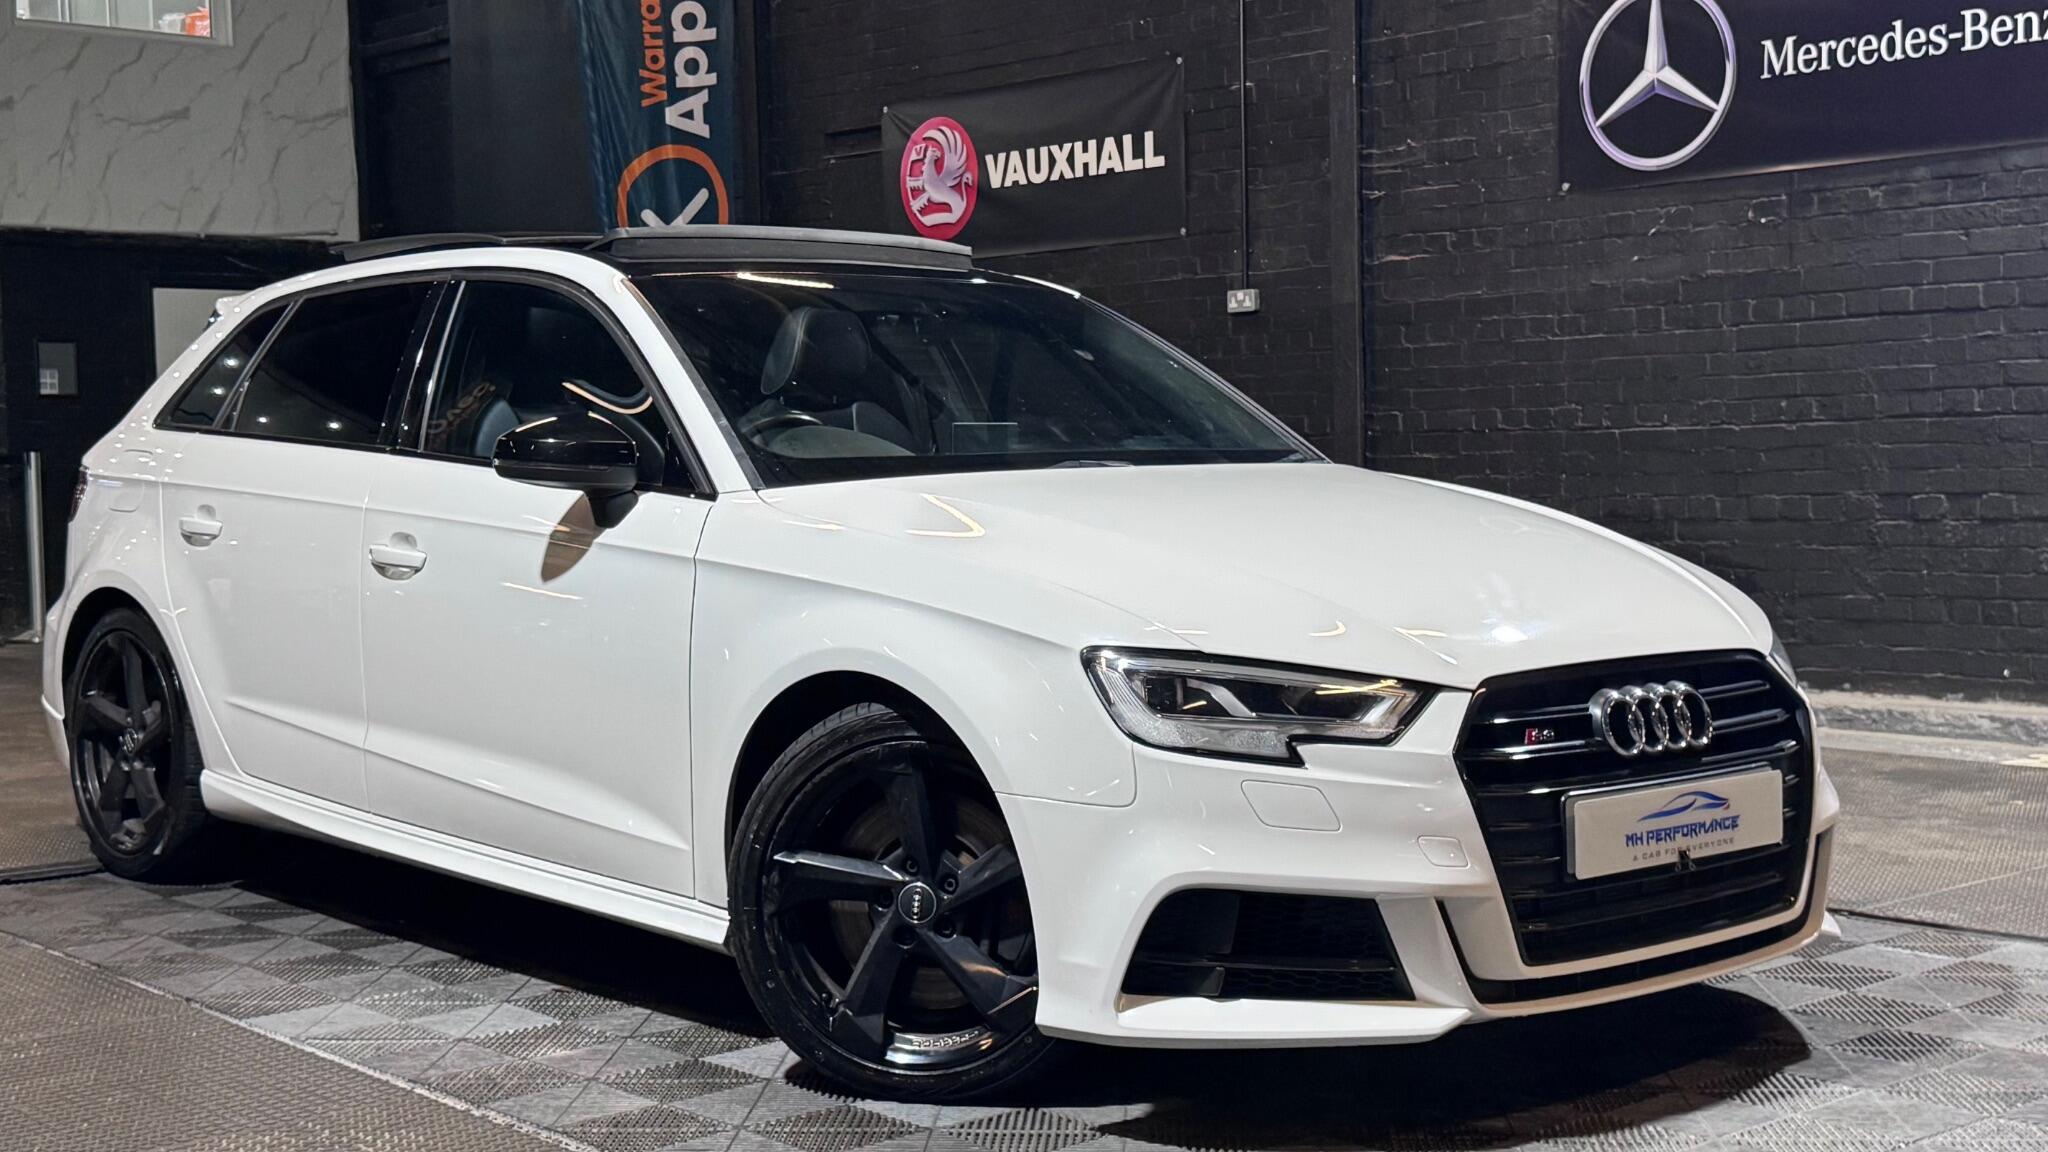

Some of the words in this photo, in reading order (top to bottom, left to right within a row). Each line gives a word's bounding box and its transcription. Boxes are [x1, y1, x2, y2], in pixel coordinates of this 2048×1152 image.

[639, 0, 668, 107] Warra
[665, 0, 717, 139] App
[984, 131, 1165, 189] VAUXHALL
[1625, 832, 1646, 848] MH
[1646, 815, 1740, 847] PERFORMANCE
[1633, 854, 1639, 862] A
